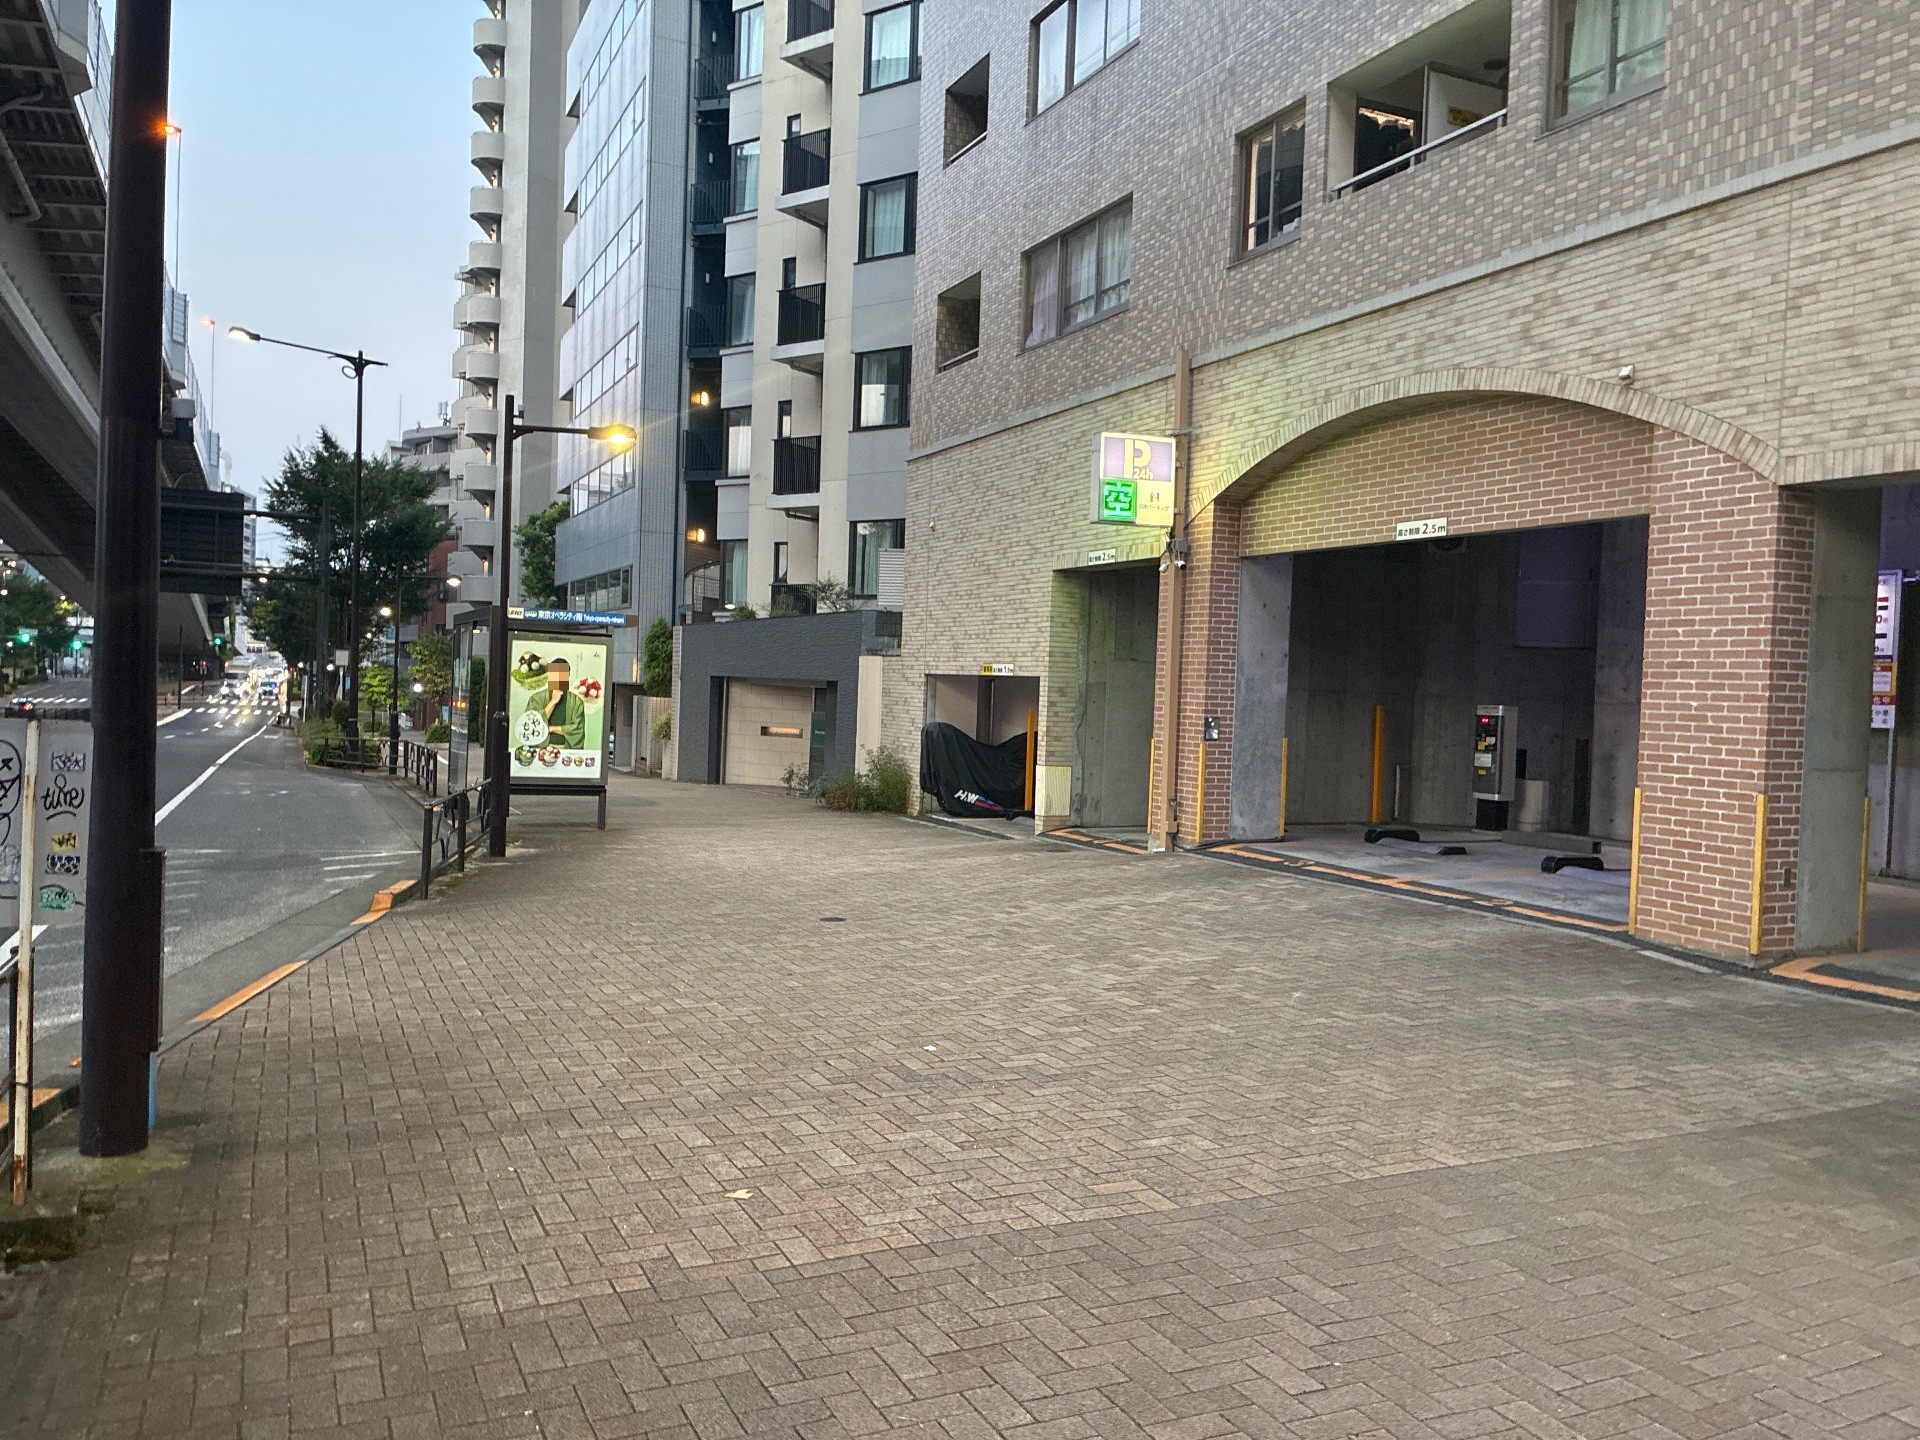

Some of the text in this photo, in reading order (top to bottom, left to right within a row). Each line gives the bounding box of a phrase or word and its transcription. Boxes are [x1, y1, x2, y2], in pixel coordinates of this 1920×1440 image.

[1123, 439, 1152, 479] P
[1133, 468, 1153, 480] 24h
[1104, 480, 1133, 518] 空
[1423, 523, 1446, 534] 2.5m
